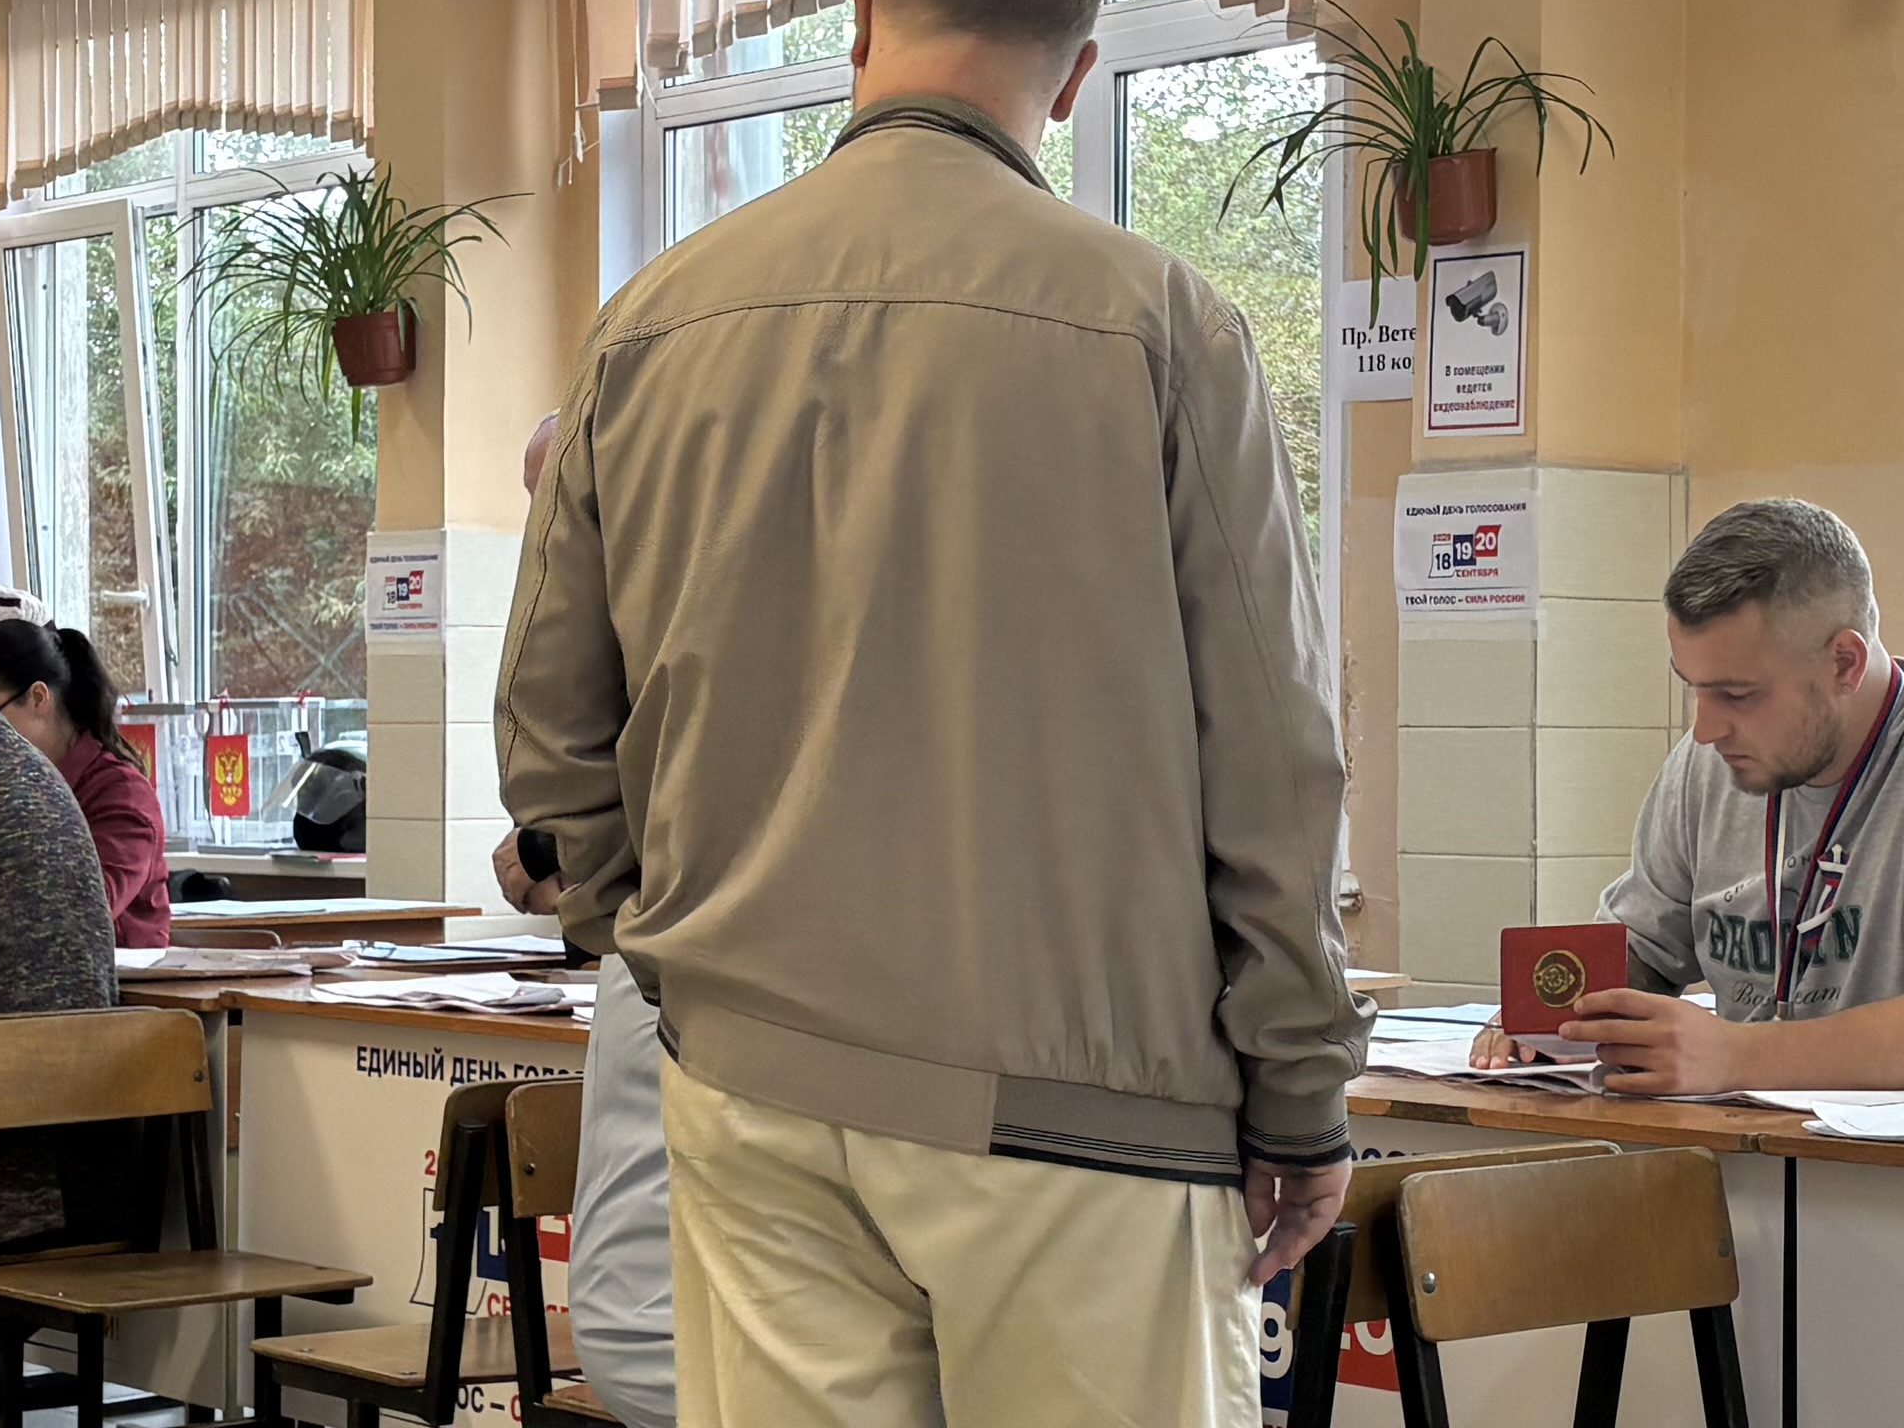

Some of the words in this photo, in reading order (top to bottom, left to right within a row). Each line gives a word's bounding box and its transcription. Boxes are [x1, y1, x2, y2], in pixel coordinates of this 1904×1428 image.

[1342, 327, 1371, 349] Пр.
[1359, 354, 1386, 372] 118
[1435, 553, 1452, 570] 18
[1455, 542, 1473, 560] 19
[1475, 532, 1497, 550] 20
[357, 1046, 444, 1081] ЕДИНЫЙ
